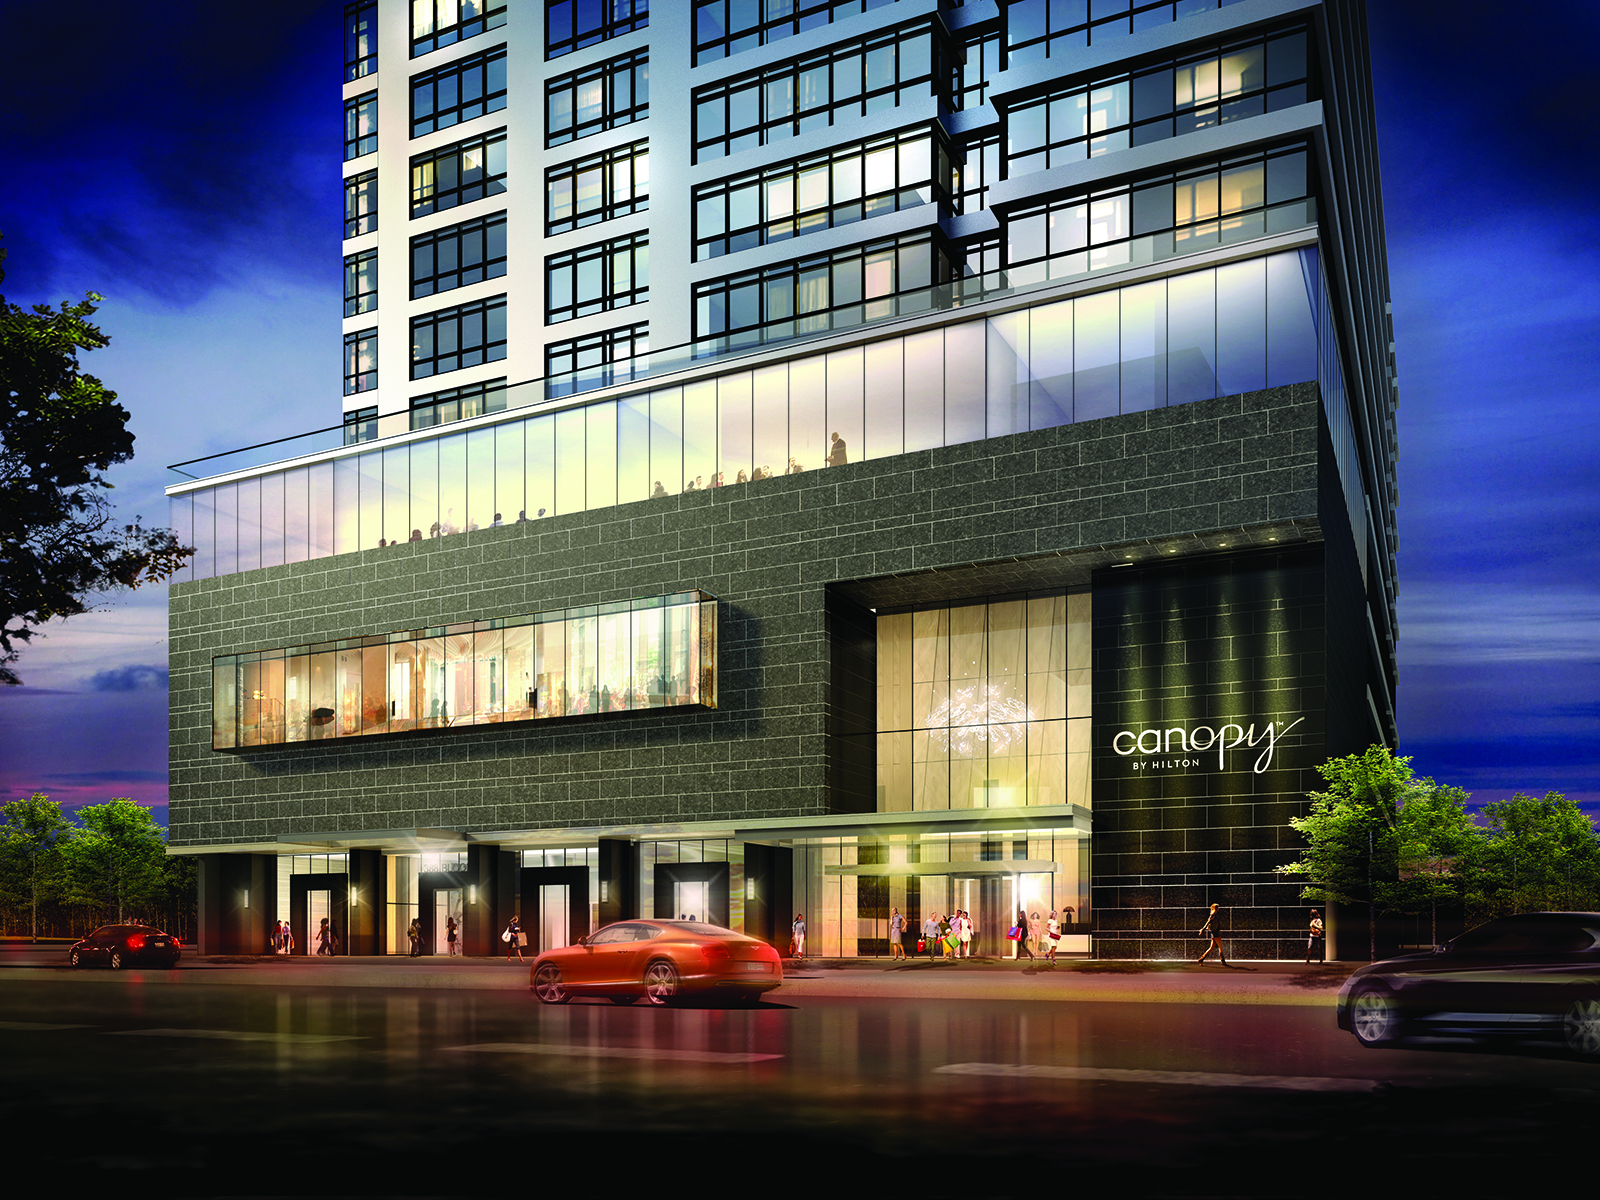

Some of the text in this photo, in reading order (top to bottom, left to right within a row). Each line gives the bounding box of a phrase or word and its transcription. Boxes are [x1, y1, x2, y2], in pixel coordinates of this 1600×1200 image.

[1112, 716, 1305, 774] canopy
[1132, 758, 1200, 770] BY HILTON
